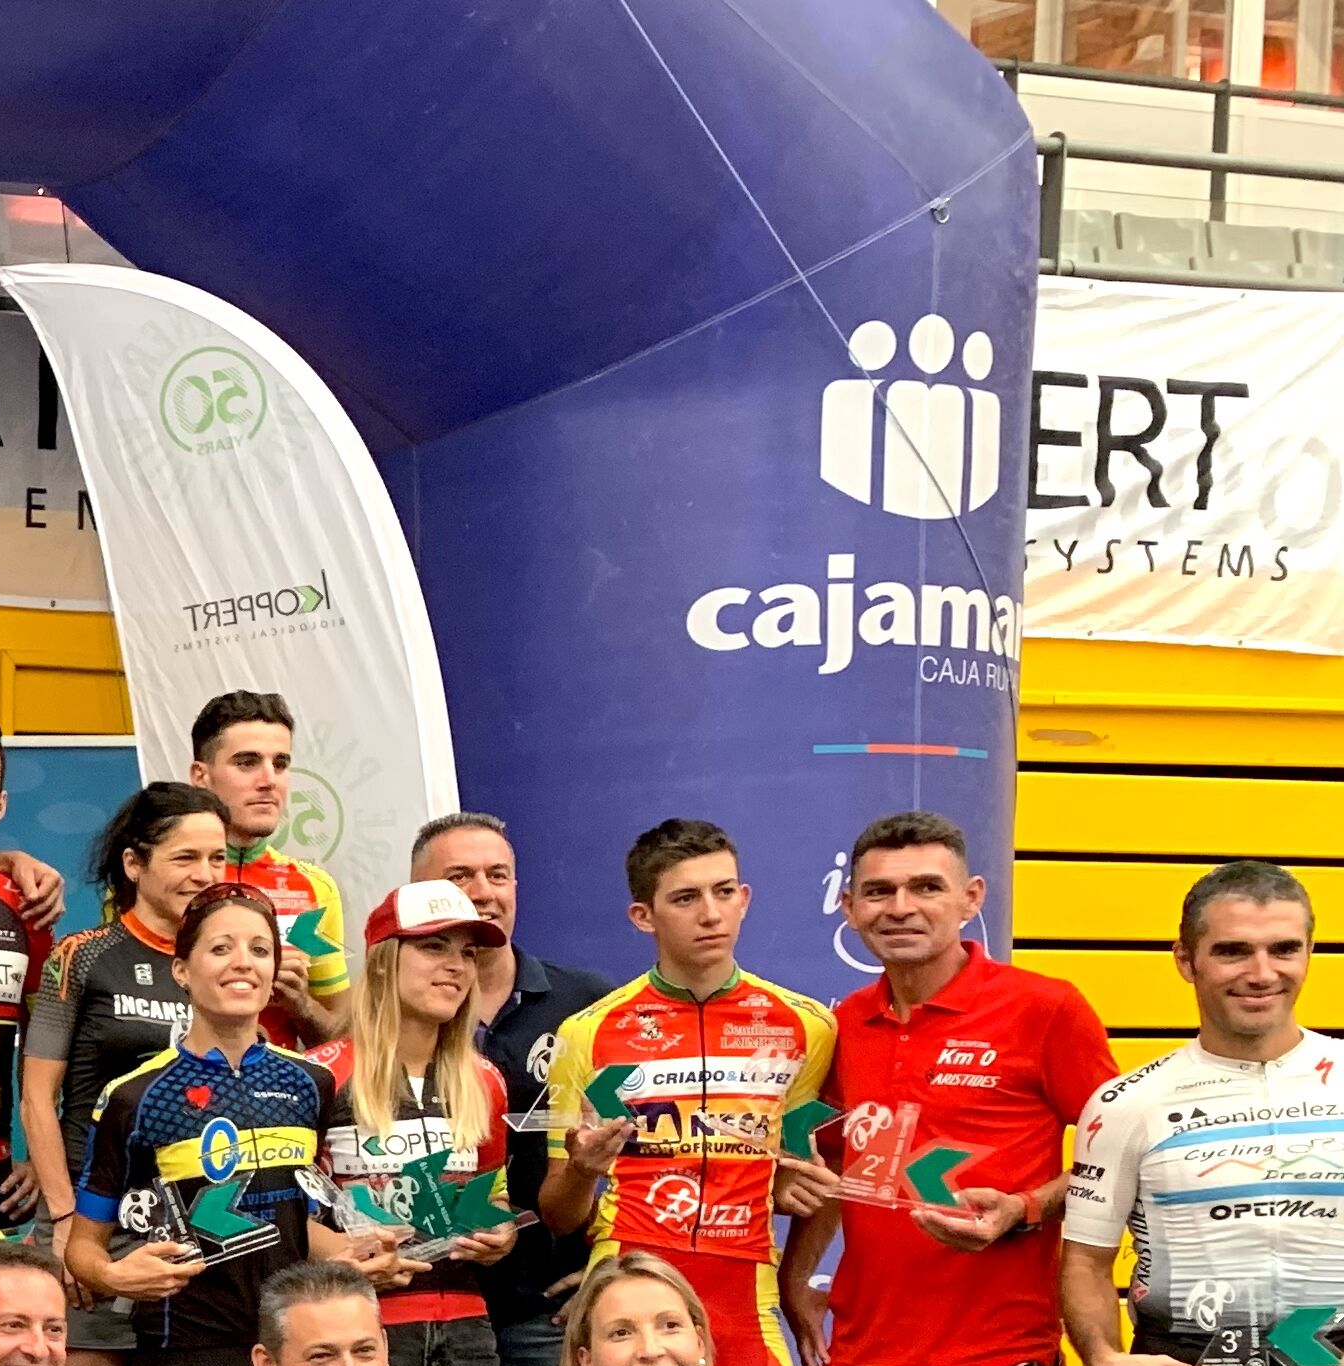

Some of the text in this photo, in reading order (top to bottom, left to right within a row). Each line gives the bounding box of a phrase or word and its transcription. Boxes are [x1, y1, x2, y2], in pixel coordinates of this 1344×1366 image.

[1029, 371, 1249, 511] ERT
[920, 656, 980, 687] CAJA
[937, 1048, 998, 1067] Km 0
[930, 1073, 1002, 1089] ARISTIDES
[354, 1128, 454, 1159] KOPPE
[1184, 1144, 1275, 1162] Cycling
[346, 1162, 407, 1172] BIOLOG
